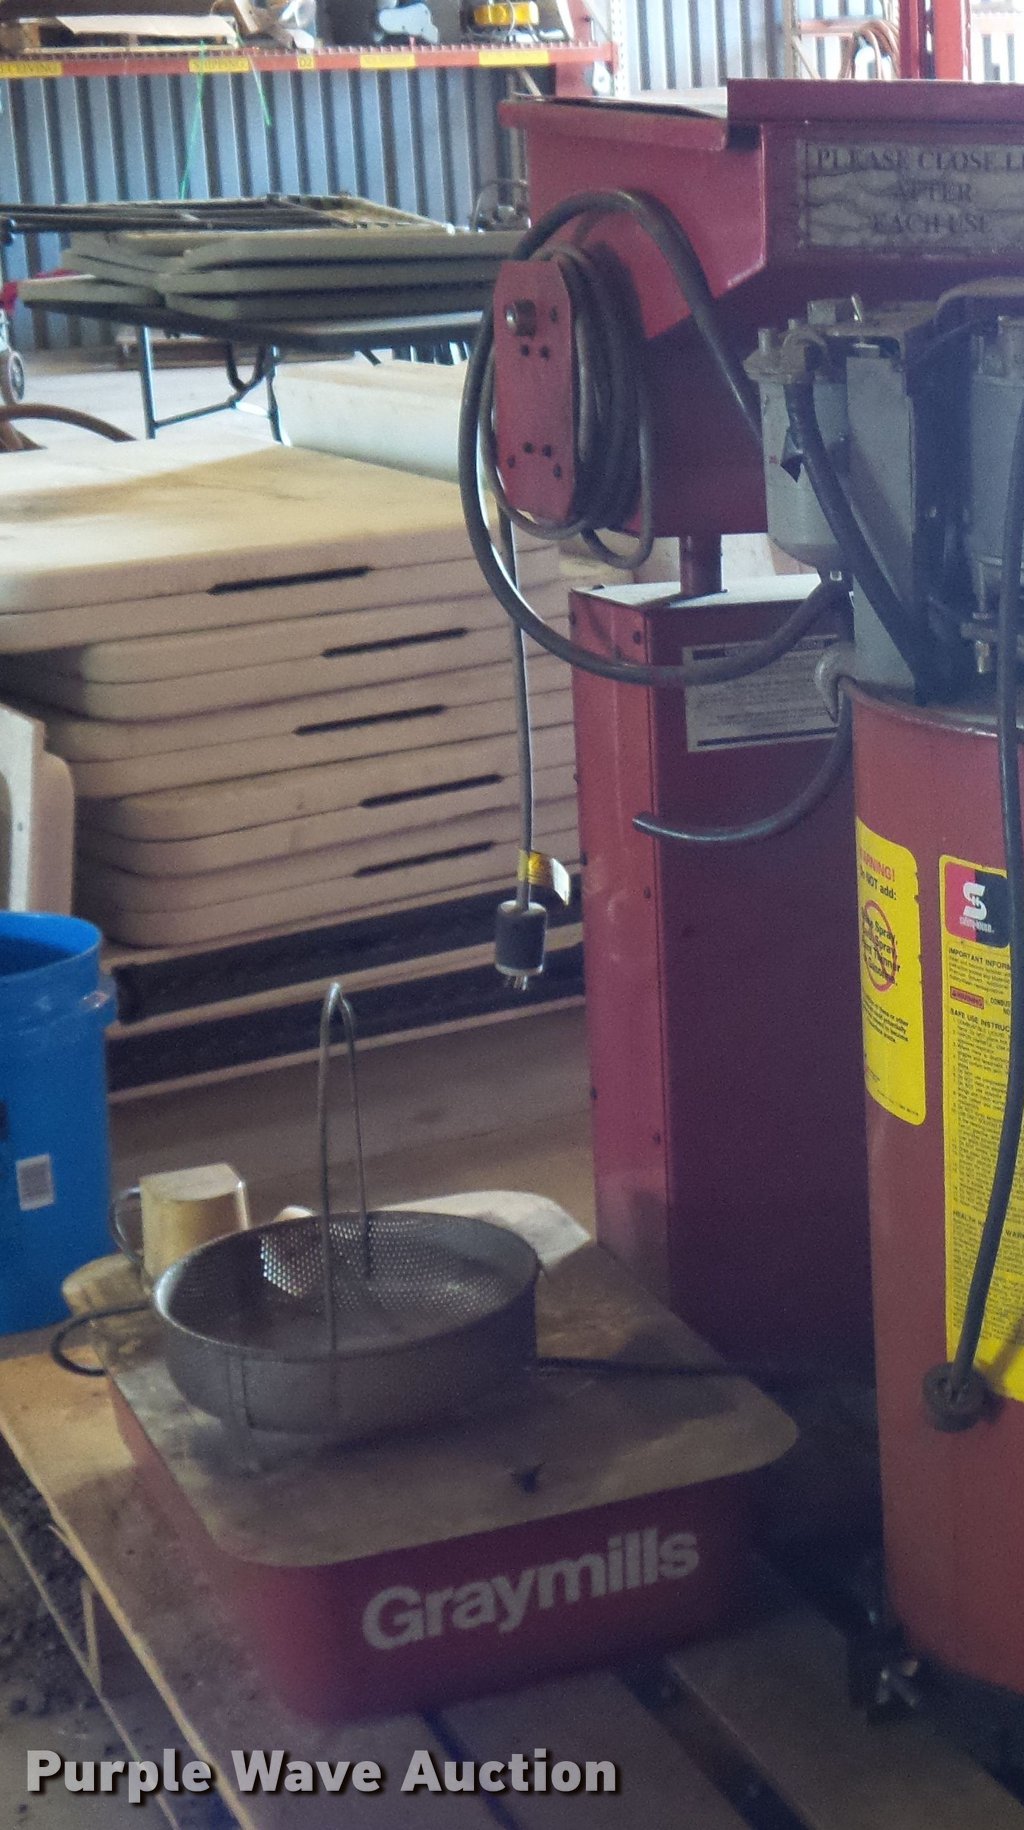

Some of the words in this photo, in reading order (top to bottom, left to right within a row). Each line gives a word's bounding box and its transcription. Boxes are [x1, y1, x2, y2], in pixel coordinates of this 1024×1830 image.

[817, 150, 906, 172] PLEASE
[917, 151, 998, 172] CLOSE
[950, 947, 983, 965] IMPORTANT
[967, 1014, 979, 1025] USE
[362, 1527, 700, 1651] Graymills
